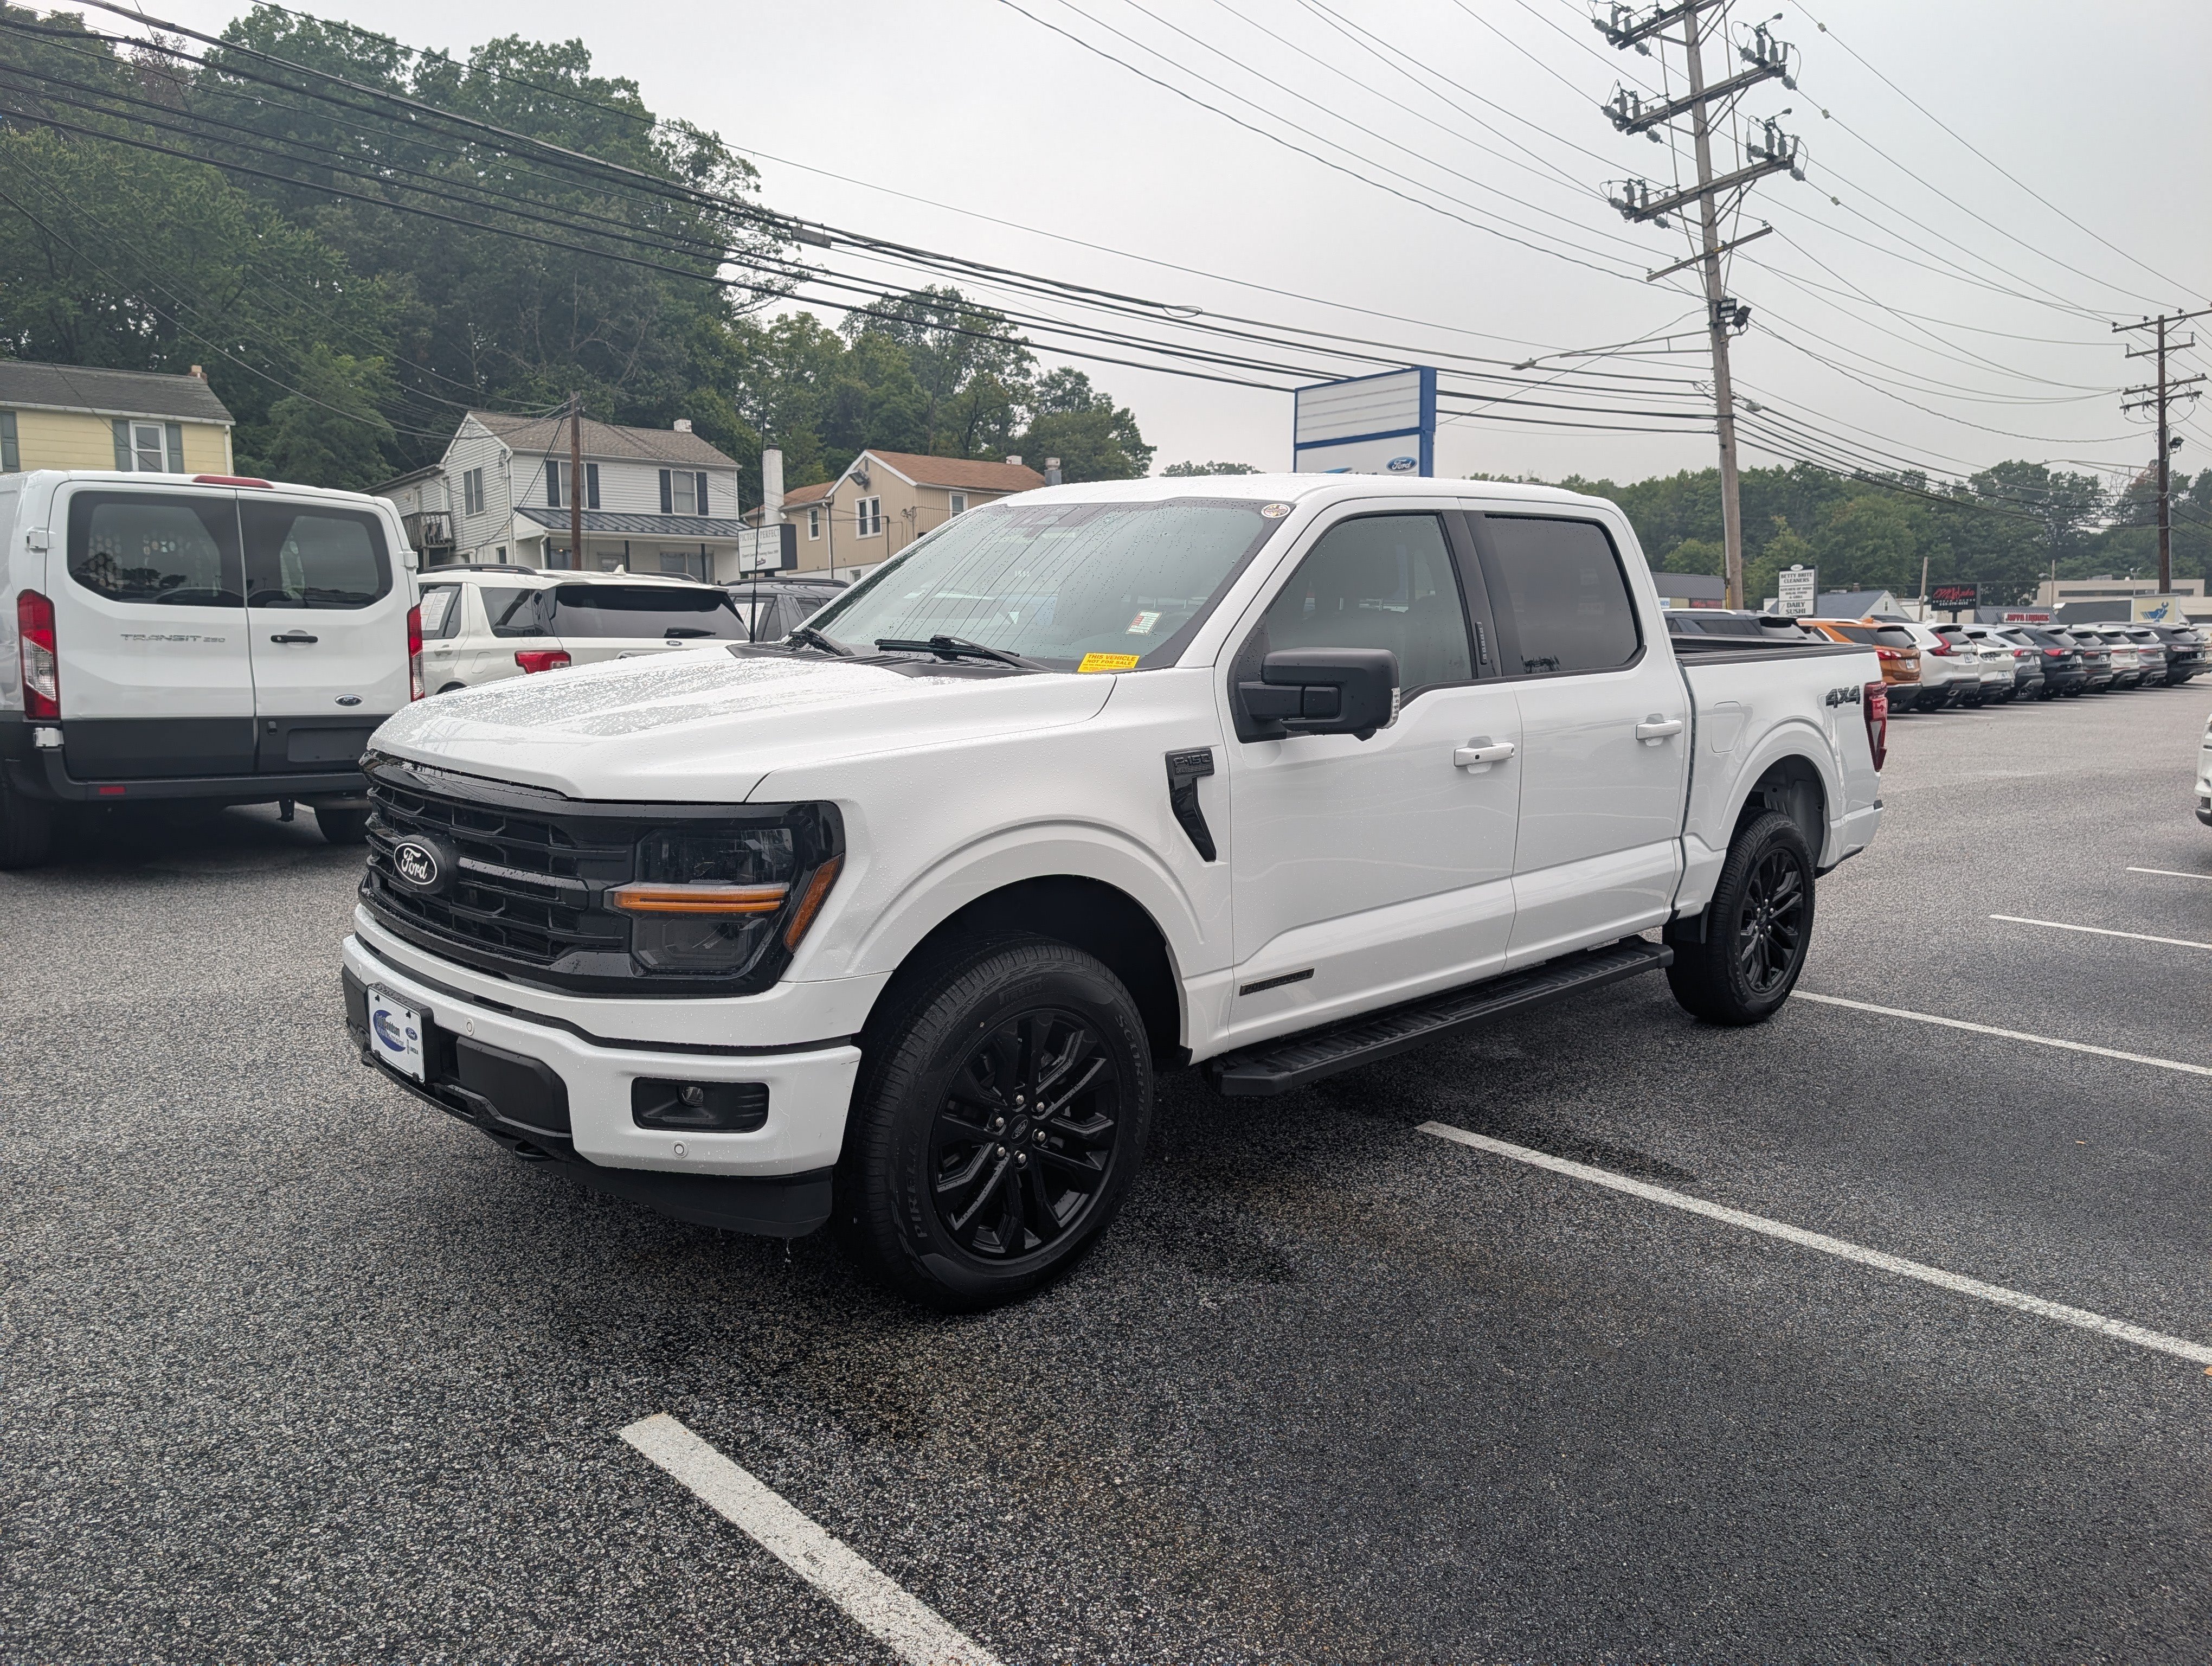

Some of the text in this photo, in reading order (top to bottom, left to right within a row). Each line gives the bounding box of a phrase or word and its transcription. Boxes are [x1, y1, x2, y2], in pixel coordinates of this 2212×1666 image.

[1391, 459, 1414, 471] Ford
[740, 529, 779, 541] PICTUR PERFECT
[120, 633, 202, 642] TRANSIT
[1173, 753, 1212, 768] F-150
[401, 847, 428, 880] Ford
